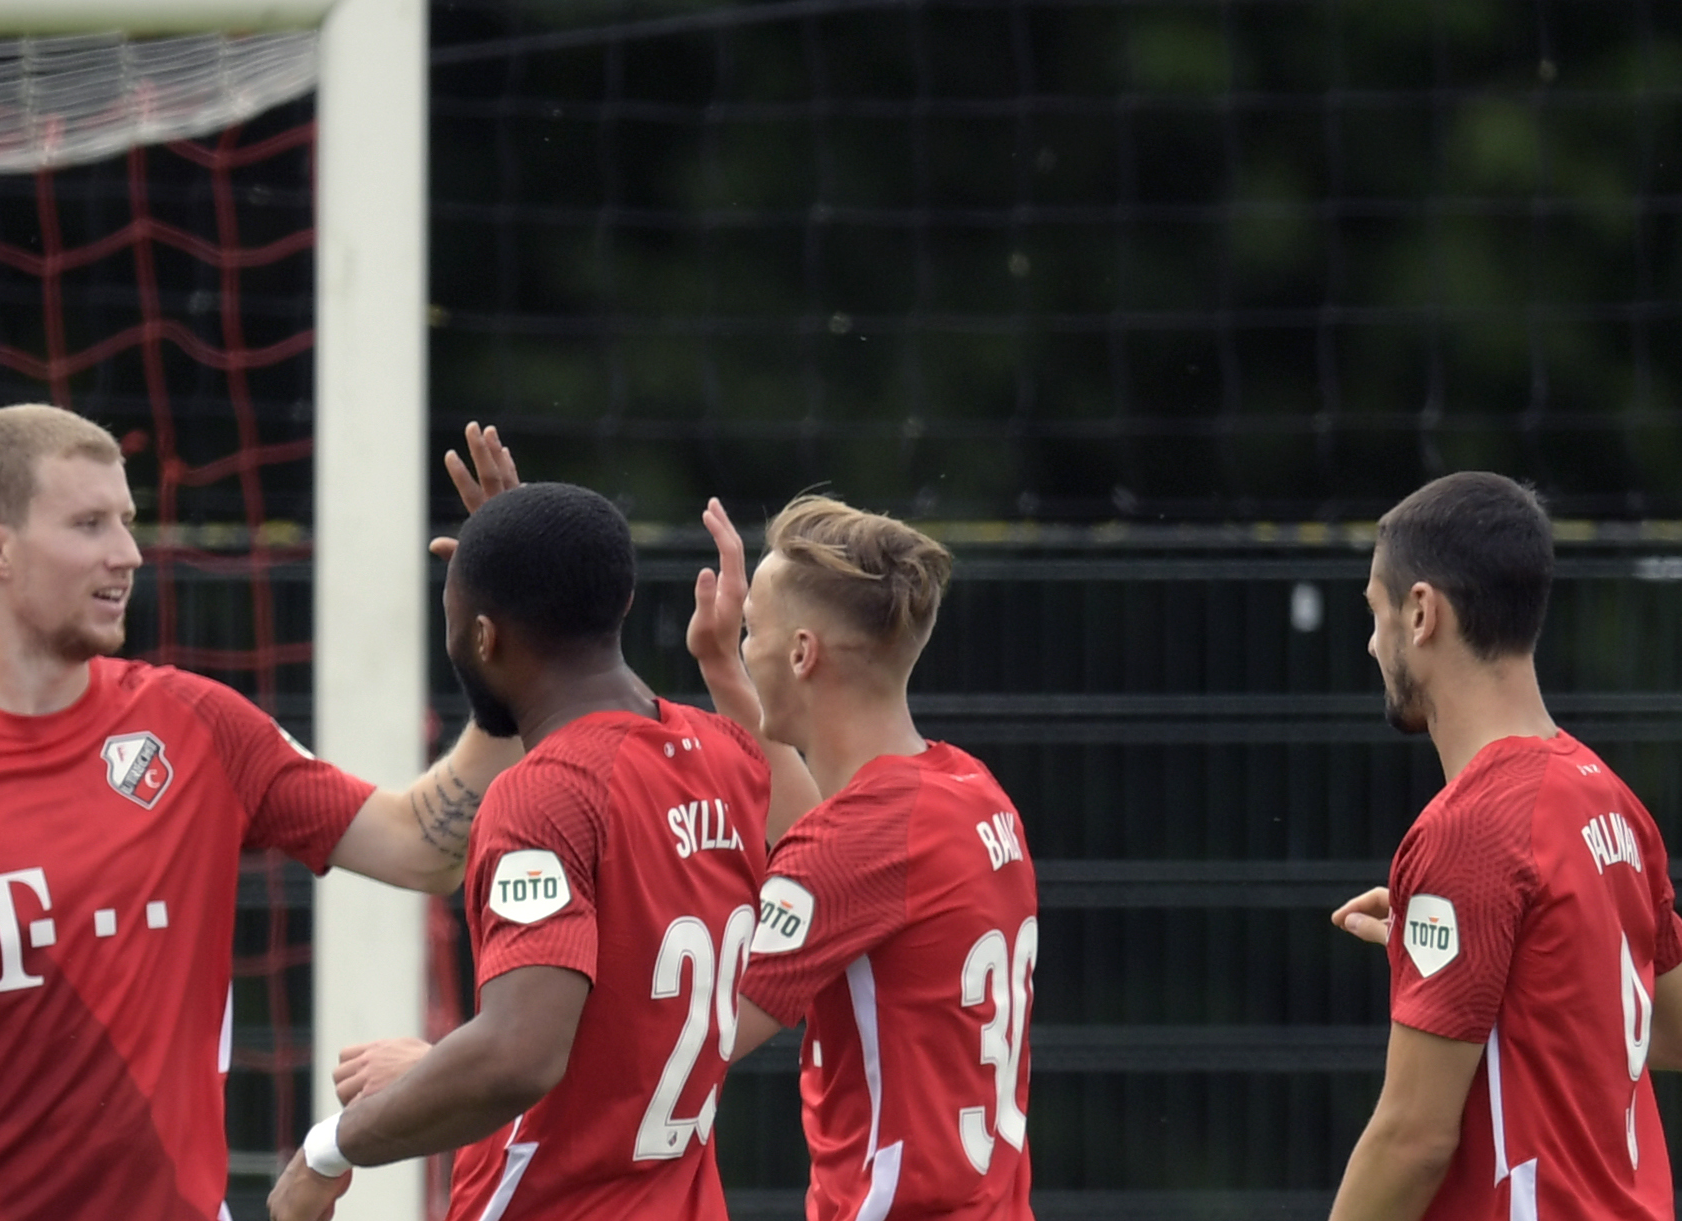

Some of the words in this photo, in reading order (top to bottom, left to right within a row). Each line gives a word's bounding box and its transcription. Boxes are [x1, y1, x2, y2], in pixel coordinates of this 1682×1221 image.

[497, 876, 558, 904] TOTO
[761, 899, 802, 939] OTO
[1409, 920, 1451, 951] TOTO
[633, 904, 757, 1161] 29
[959, 915, 1039, 1176] 30
